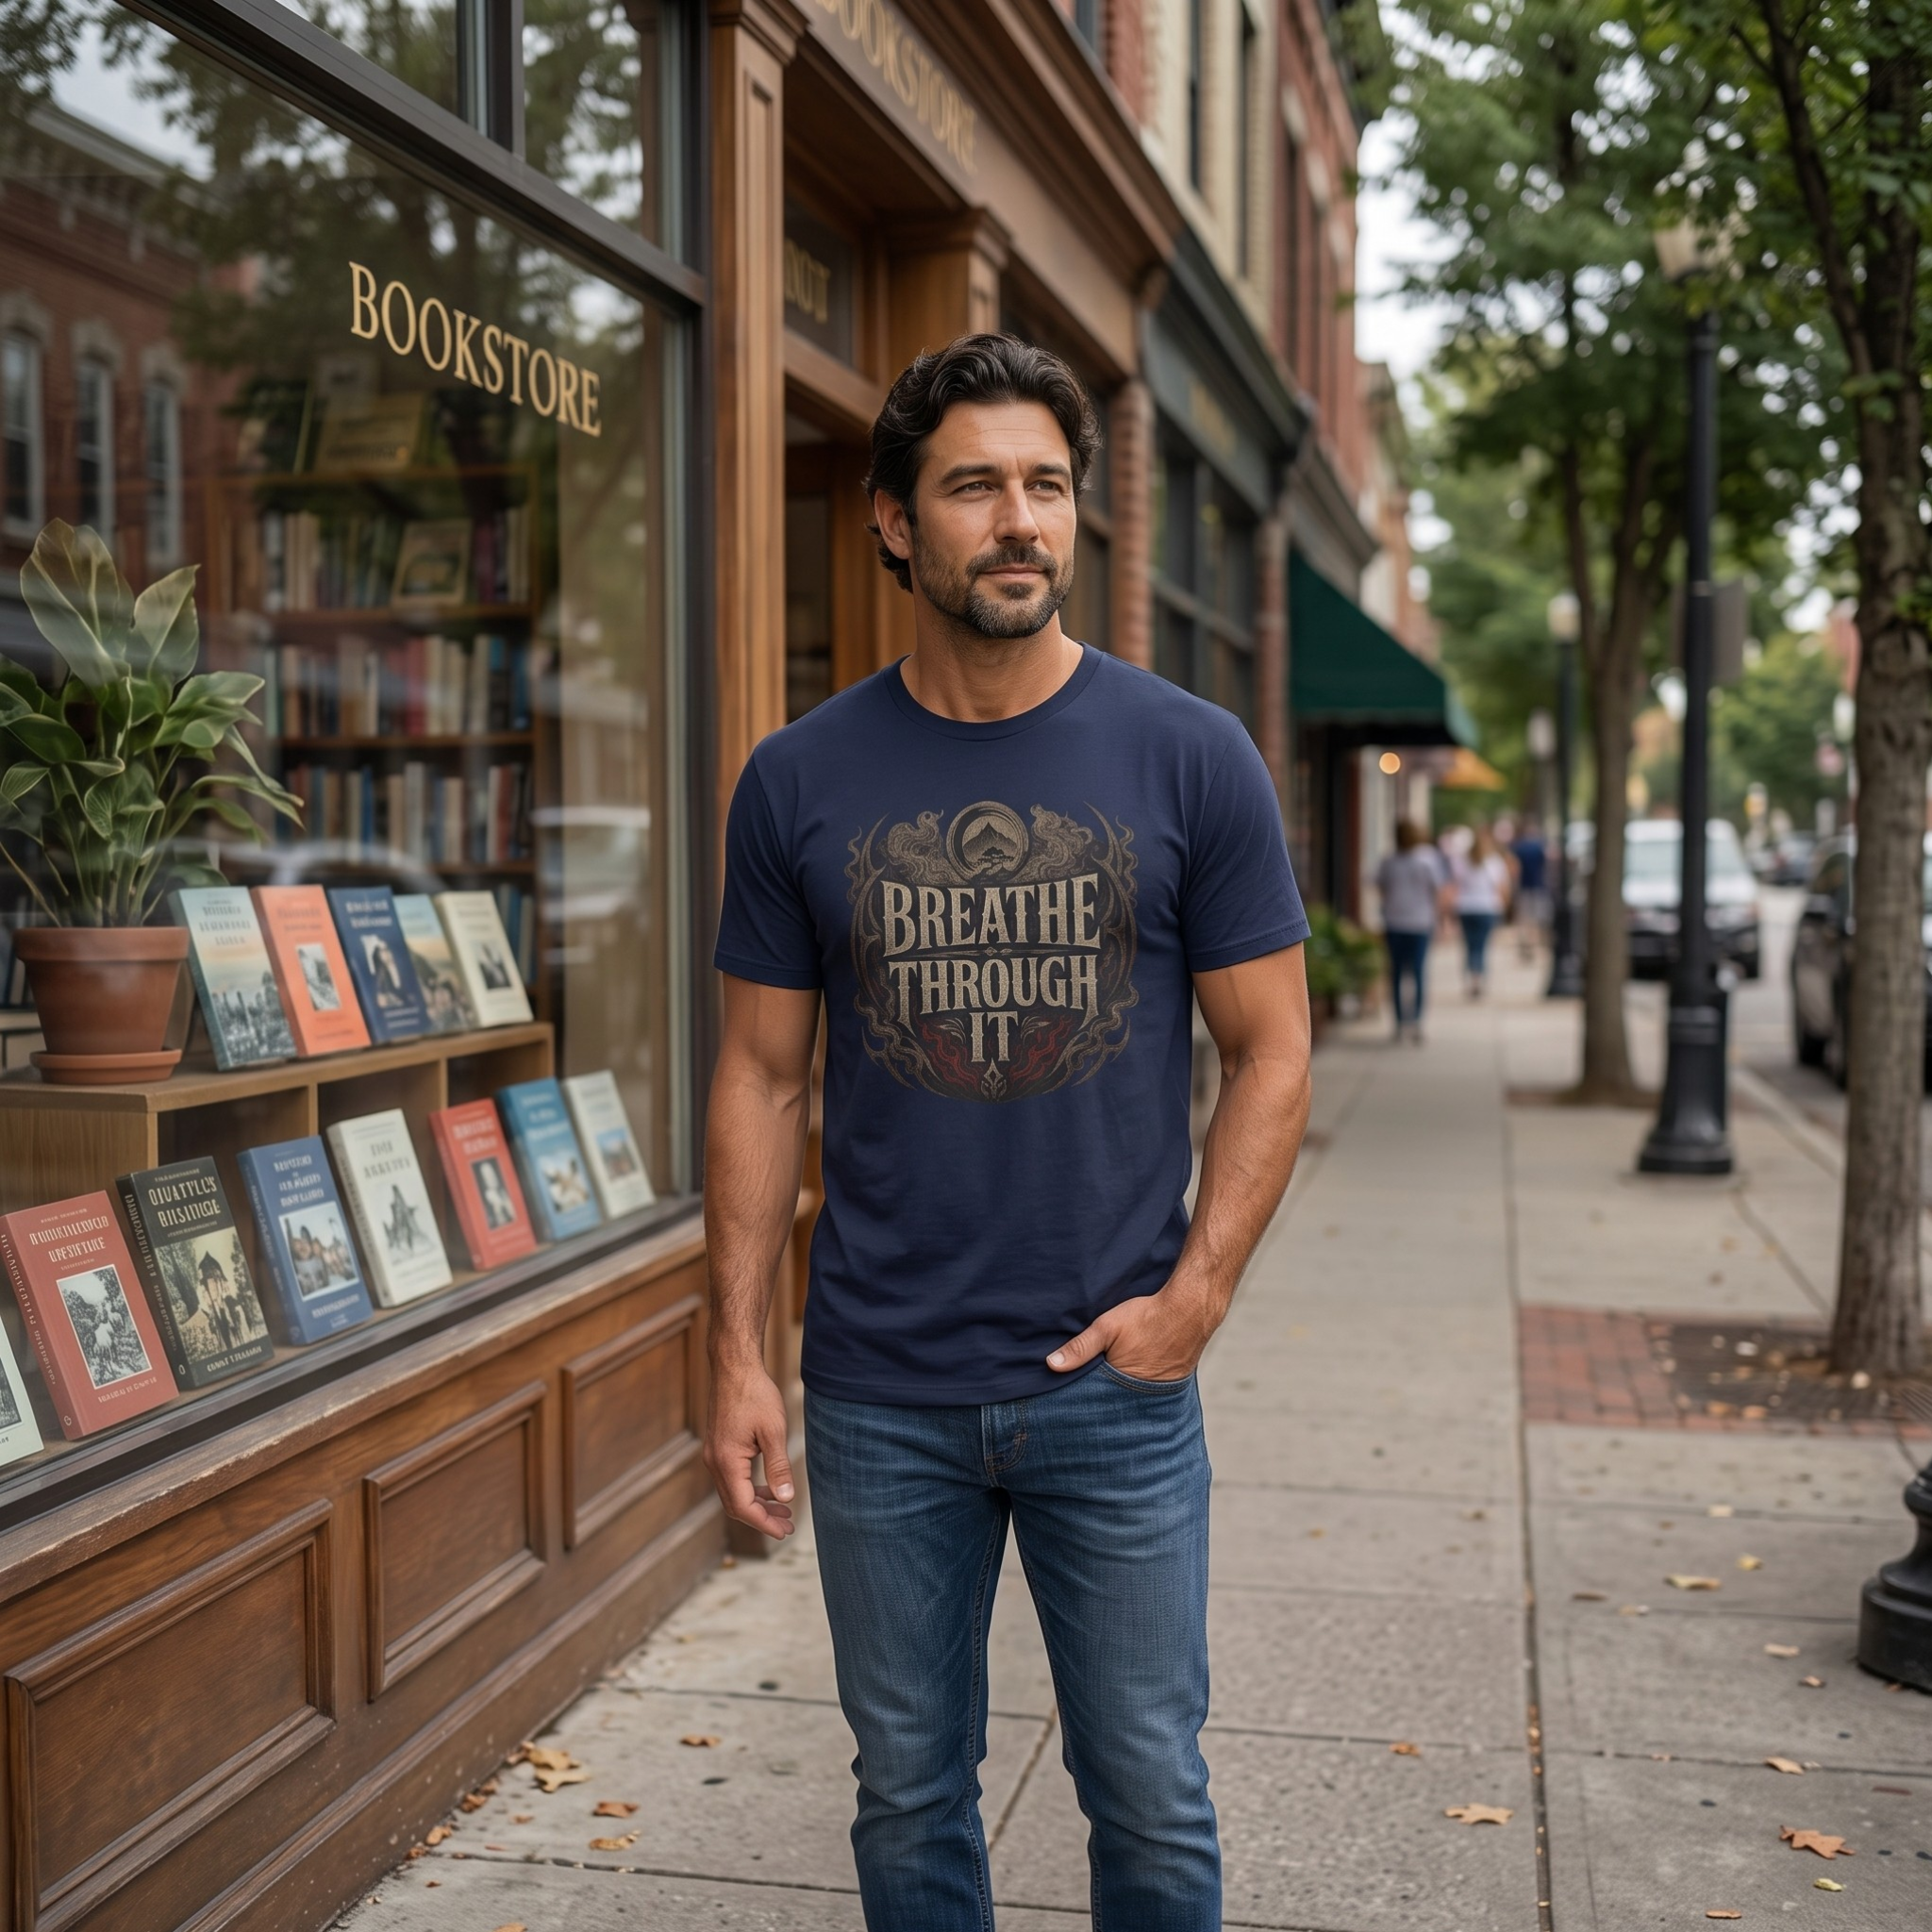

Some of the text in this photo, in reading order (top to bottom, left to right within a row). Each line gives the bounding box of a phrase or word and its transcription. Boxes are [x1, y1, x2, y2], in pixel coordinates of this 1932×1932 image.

[816, 0, 978, 175] OOKSTORE
[349, 261, 601, 438] BOOKSTORE
[881, 873, 1101, 957] BREATHE
[889, 955, 1099, 1038] THROUGH
[970, 1010, 1018, 1062] IT
